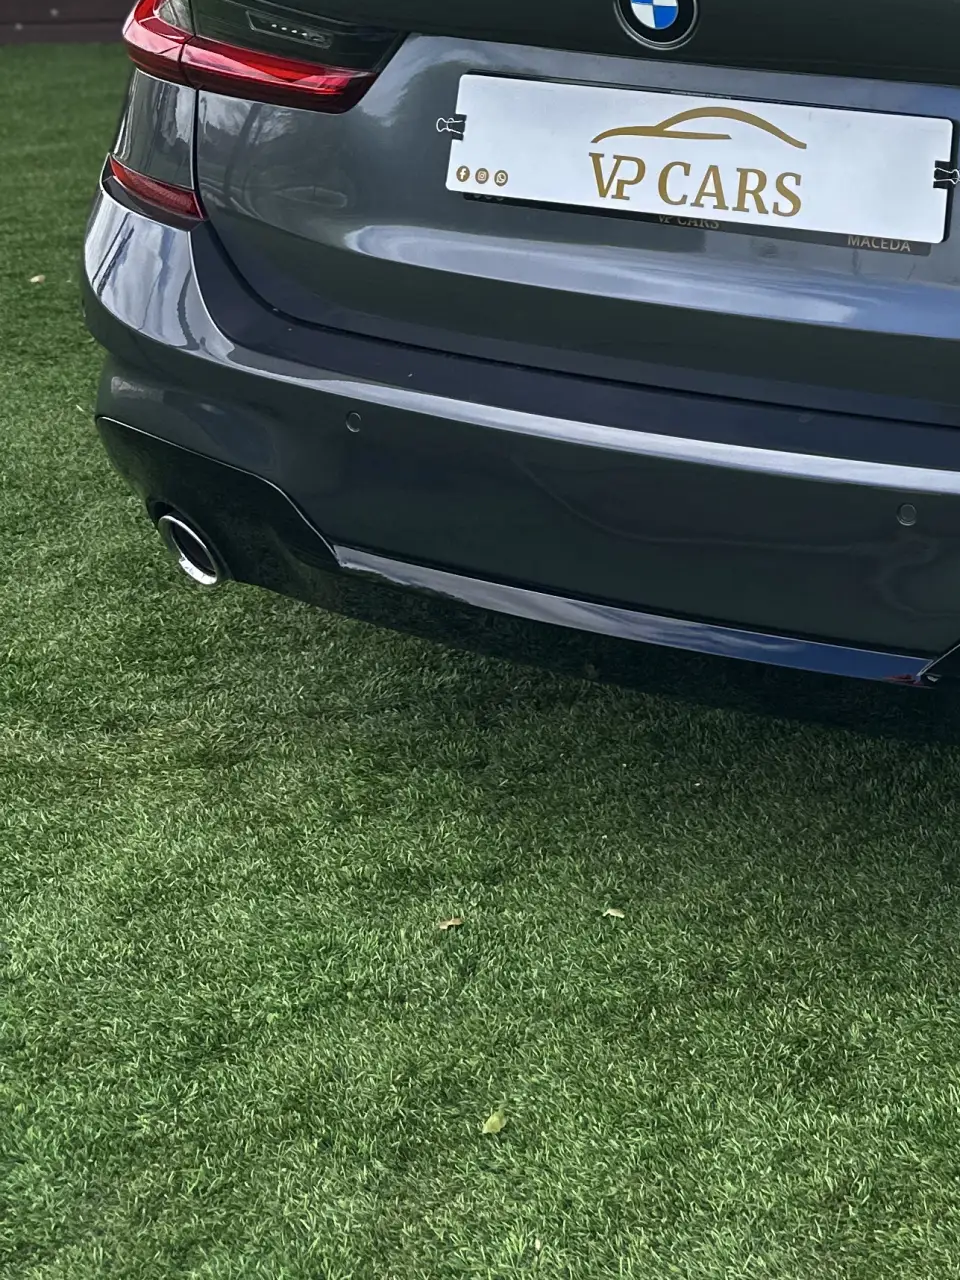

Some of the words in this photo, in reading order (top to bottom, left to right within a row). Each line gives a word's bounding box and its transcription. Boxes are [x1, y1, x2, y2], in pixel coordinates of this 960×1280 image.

[588, 152, 646, 201] VP
[657, 160, 803, 218] CARS
[847, 235, 911, 252] MACEDA
